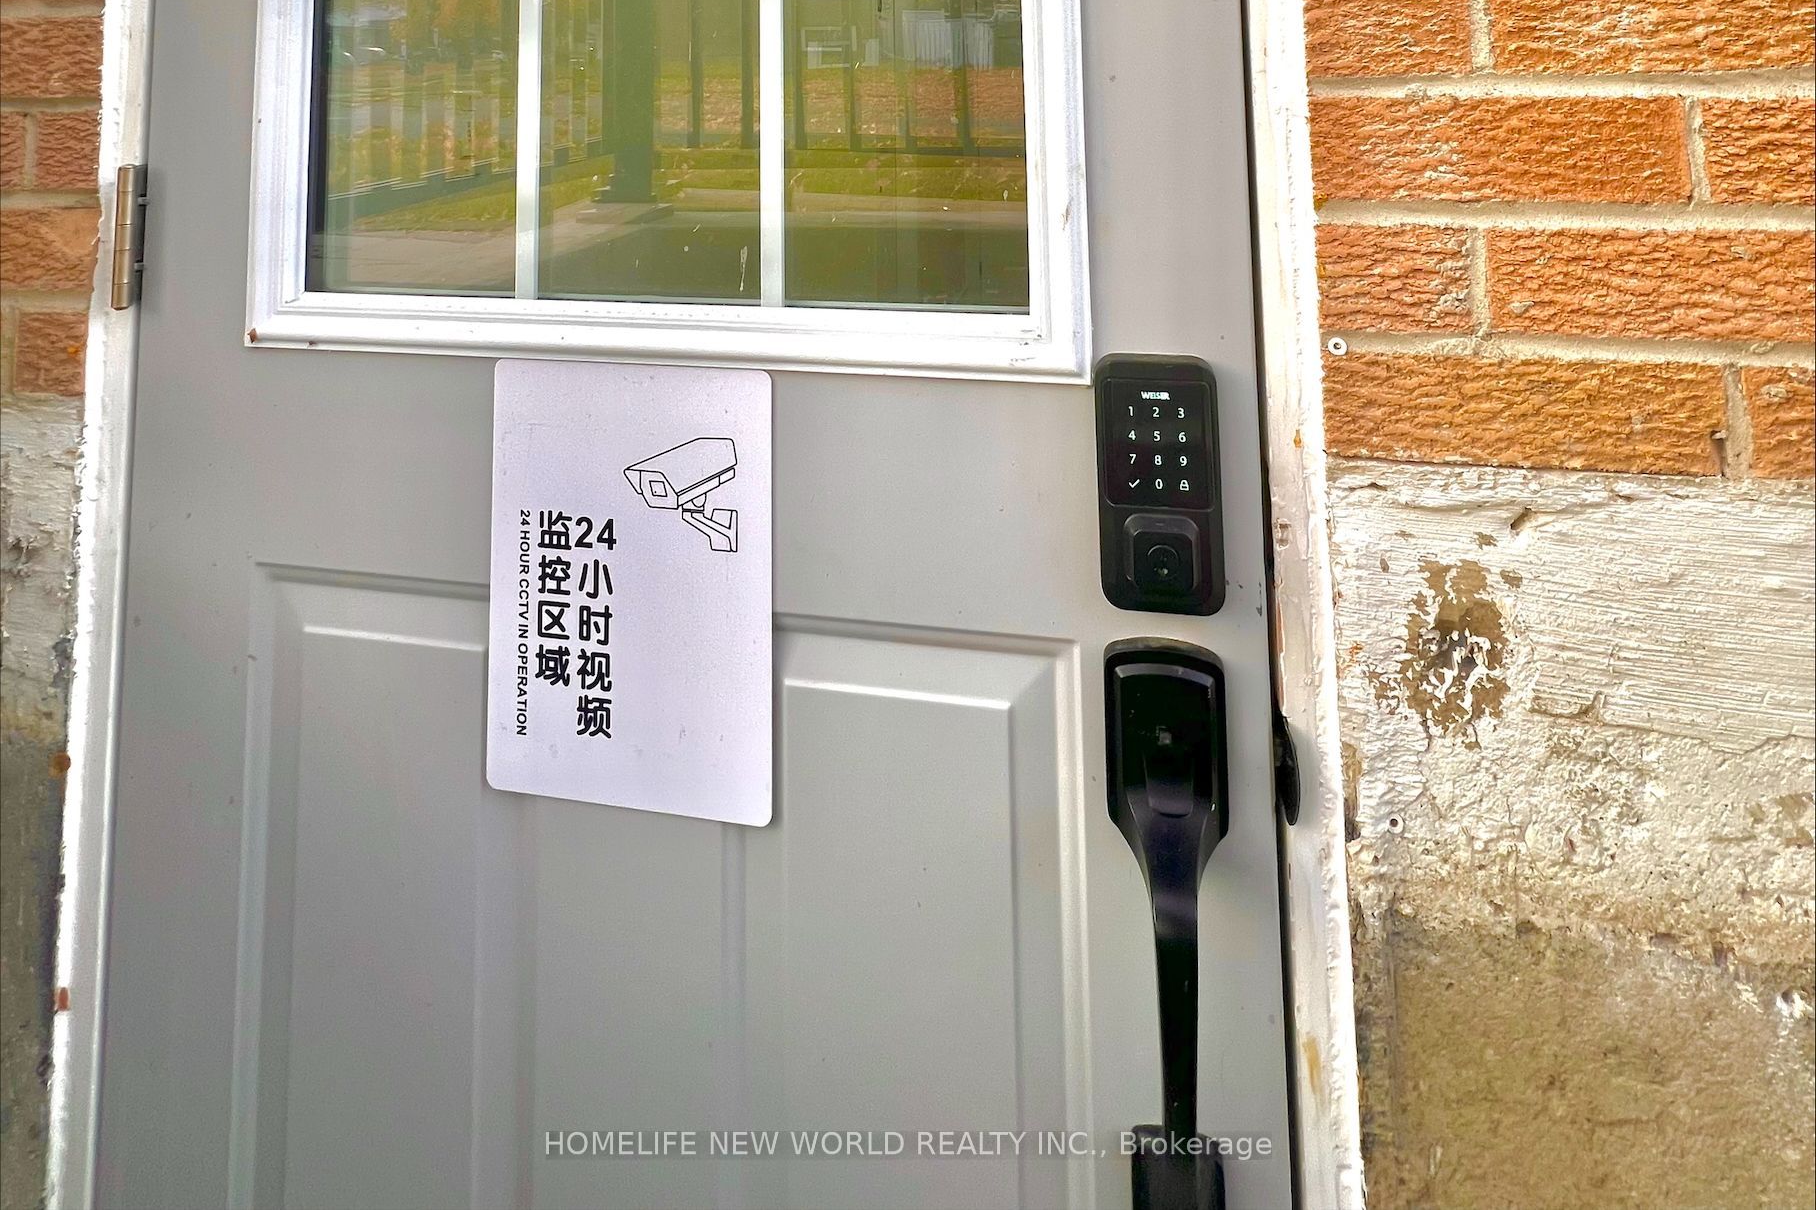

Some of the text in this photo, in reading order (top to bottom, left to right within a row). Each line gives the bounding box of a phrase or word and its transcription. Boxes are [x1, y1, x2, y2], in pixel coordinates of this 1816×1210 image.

[1140, 391, 1171, 401] WEISER
[1128, 405, 1185, 419] 1 2 3
[1128, 429, 1187, 443] 4 5 6
[1128, 453, 1188, 467] 7 8 9
[1155, 478, 1163, 490] 0
[535, 510, 573, 687] 监控区域
[516, 509, 531, 736] 24 HOUR CCTV IN OPERATION
